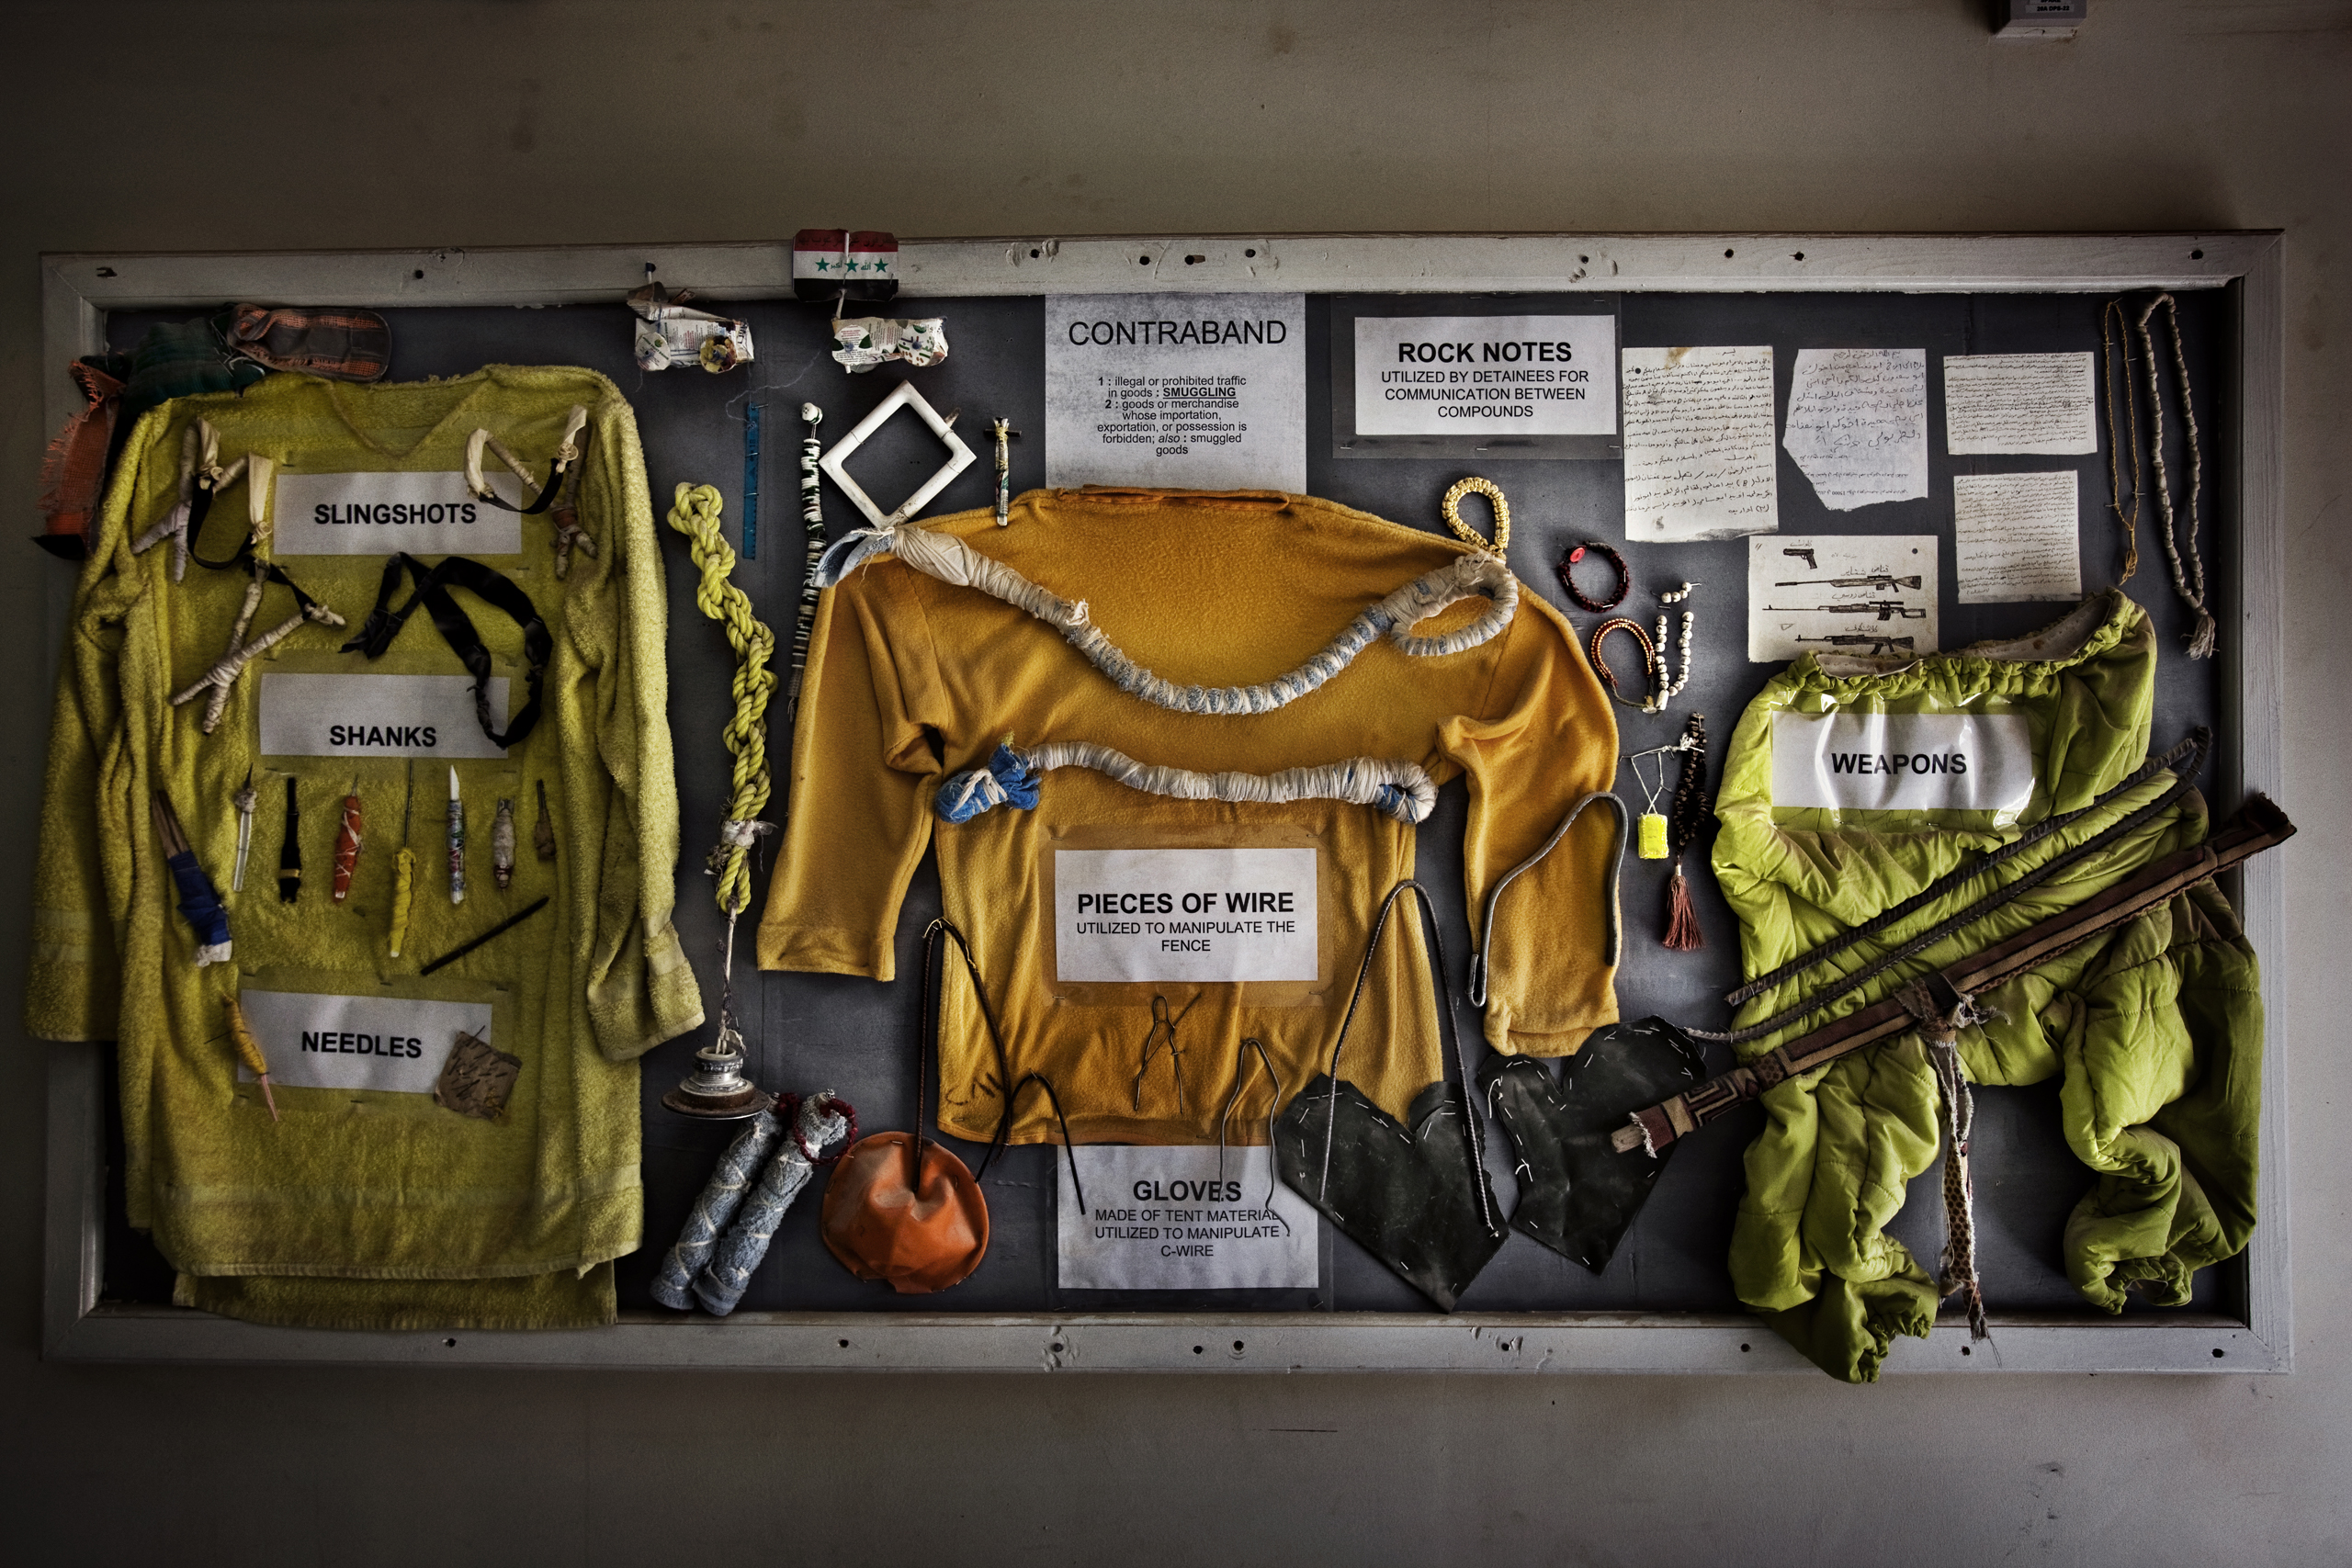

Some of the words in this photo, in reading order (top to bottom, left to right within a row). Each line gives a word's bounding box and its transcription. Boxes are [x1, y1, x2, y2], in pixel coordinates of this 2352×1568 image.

[1069, 321, 1286, 345] CONTRABAND
[1398, 343, 1475, 363] ROCK
[1484, 342, 1572, 362] NOTES
[1098, 377, 1103, 386] 1
[1115, 377, 1145, 388] illegal
[1162, 376, 1214, 388] prohibited
[1217, 376, 1246, 386] traffic
[1382, 371, 1445, 383] UTILIZED
[1450, 371, 1468, 383] BY
[1473, 370, 1555, 382] DETAINEES
[1559, 370, 1589, 382] FOR
[1108, 388, 1117, 398] in
[1121, 387, 1152, 399] goods
[1162, 388, 1236, 399] SMUGGLING
[1385, 388, 1510, 400] COMMUNICATION
[1515, 388, 1585, 400] BETWEEN
[1105, 399, 1112, 409] 2
[1122, 399, 1154, 410] goods
[1171, 399, 1238, 408] merchandise
[1122, 410, 1157, 420] whose
[1160, 410, 1221, 422] importation,
[1438, 405, 1533, 418] COMPOUNDS
[1097, 422, 1159, 433] exportation,
[1162, 423, 1173, 432] or
[1176, 422, 1235, 433] possession
[1238, 422, 1247, 431] is
[1102, 433, 1155, 444] forbidden;
[1159, 434, 1181, 443] also
[1191, 434, 1241, 445] smuggled
[1156, 445, 1188, 457] goods
[314, 502, 477, 525] SLINGSHOTS
[330, 725, 436, 748] SHANKS
[1831, 753, 1967, 774] WEAPONS
[1078, 893, 1173, 914] PIECES
[1182, 893, 1217, 913] OF
[1226, 892, 1294, 913] WIRE
[1077, 922, 1140, 934] UTILIZED
[1145, 922, 1165, 934] TO
[1170, 921, 1262, 933] MANIPULATE
[1267, 921, 1295, 932] THE
[1162, 940, 1211, 952] FENCE
[301, 1031, 422, 1058] NEEDLES
[1133, 1179, 1241, 1201] GLOVES
[1095, 1209, 1136, 1221] MADE
[1141, 1209, 1161, 1222] OF
[1165, 1210, 1204, 1222] TENT
[1095, 1226, 1159, 1239] UTILIZED
[1162, 1227, 1183, 1239] TO
[1188, 1225, 1279, 1239] MANIPULATE
[1160, 1245, 1214, 1258] C-WIRE
